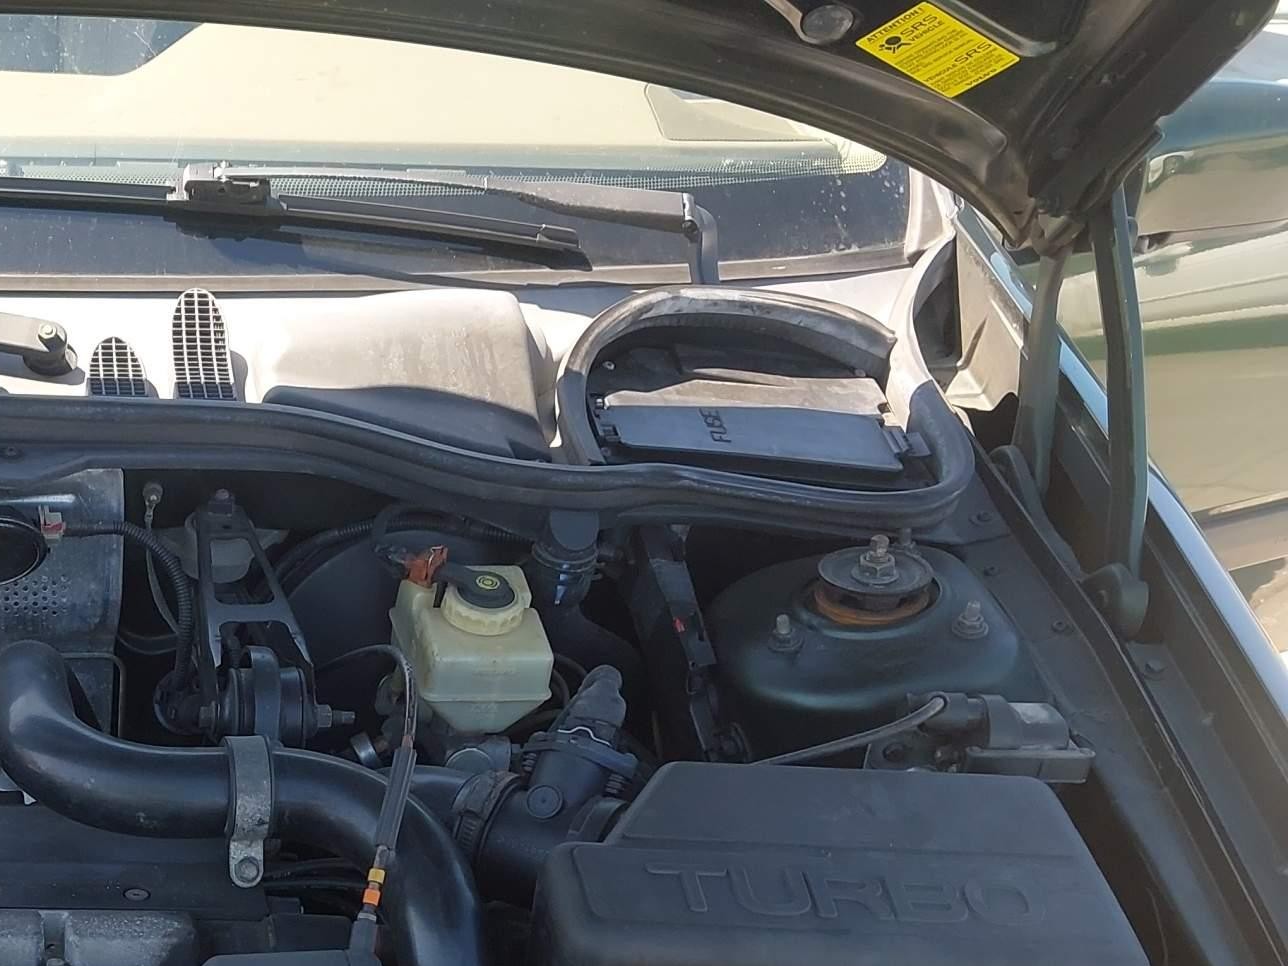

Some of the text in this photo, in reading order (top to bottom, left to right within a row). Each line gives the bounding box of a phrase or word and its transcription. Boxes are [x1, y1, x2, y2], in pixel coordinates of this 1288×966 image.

[866, 9, 919, 43] ATTENTION
[900, 14, 938, 39] SRS
[954, 41, 992, 65] SRS
[698, 408, 732, 443] FUSE
[644, 860, 1042, 926] TURBO
